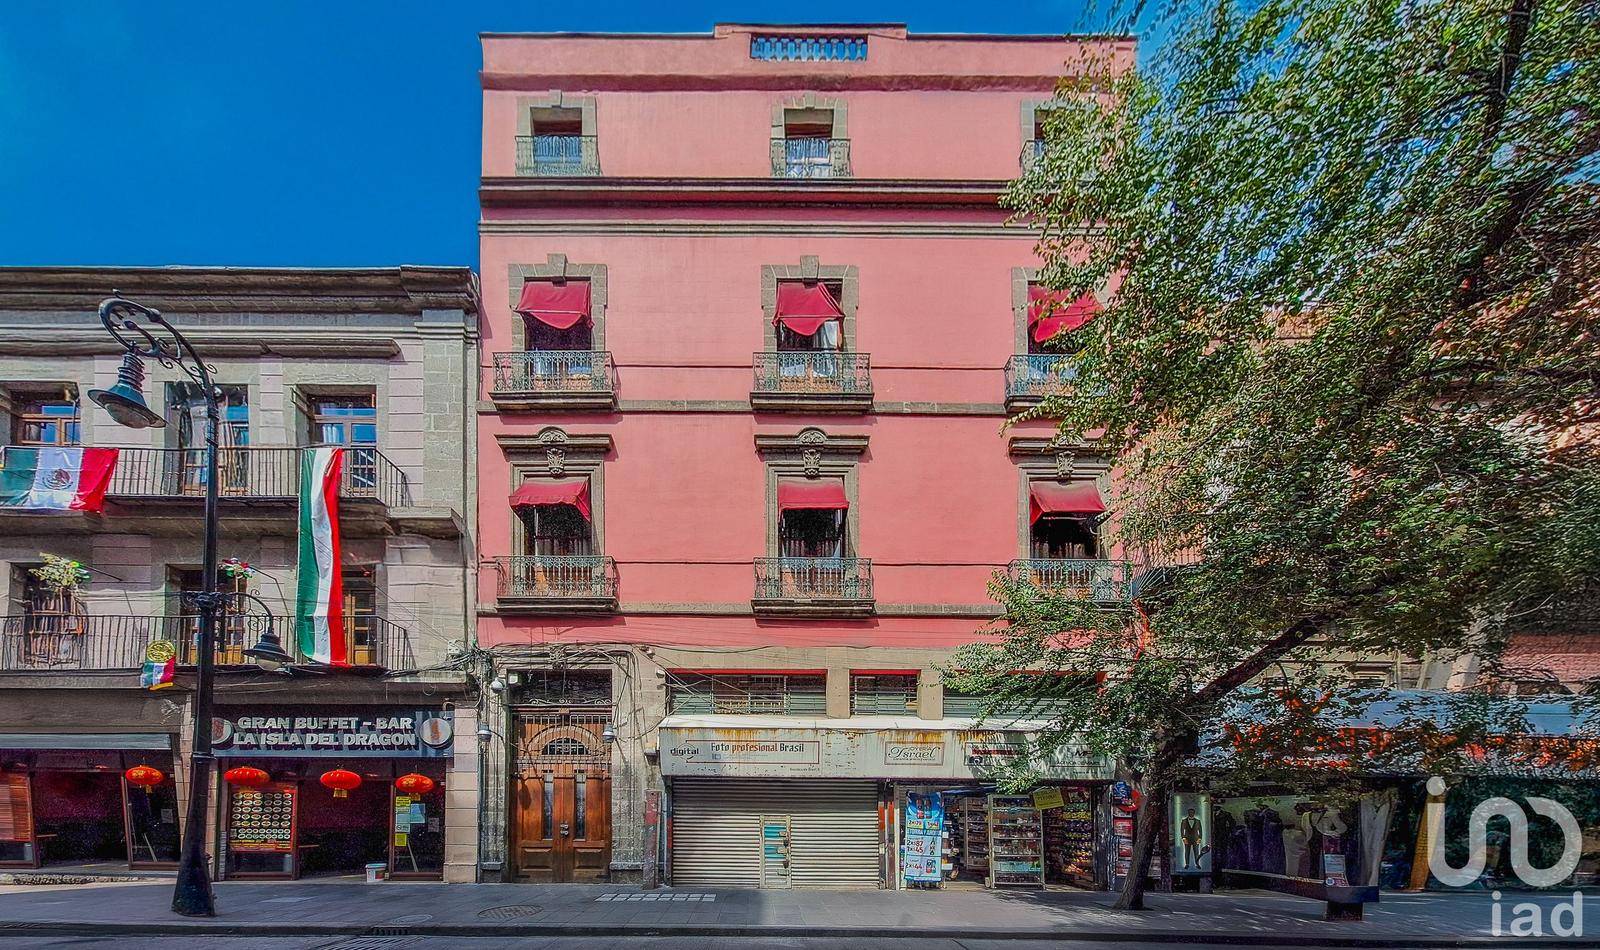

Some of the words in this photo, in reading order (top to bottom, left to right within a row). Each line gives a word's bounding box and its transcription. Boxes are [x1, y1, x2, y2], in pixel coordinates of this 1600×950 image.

[237, 716, 290, 729] GRAN
[295, 716, 359, 729] BUFFET
[375, 716, 413, 729] BAR
[233, 733, 257, 745] LA
[260, 733, 301, 745] ISLA
[305, 733, 339, 745] DEL
[343, 733, 416, 745] DRAGON
[670, 747, 699, 757] digital
[711, 742, 730, 752] Foto
[731, 742, 778, 753] profesional
[779, 742, 804, 753] Brasil
[888, 746, 941, 759] Israel
